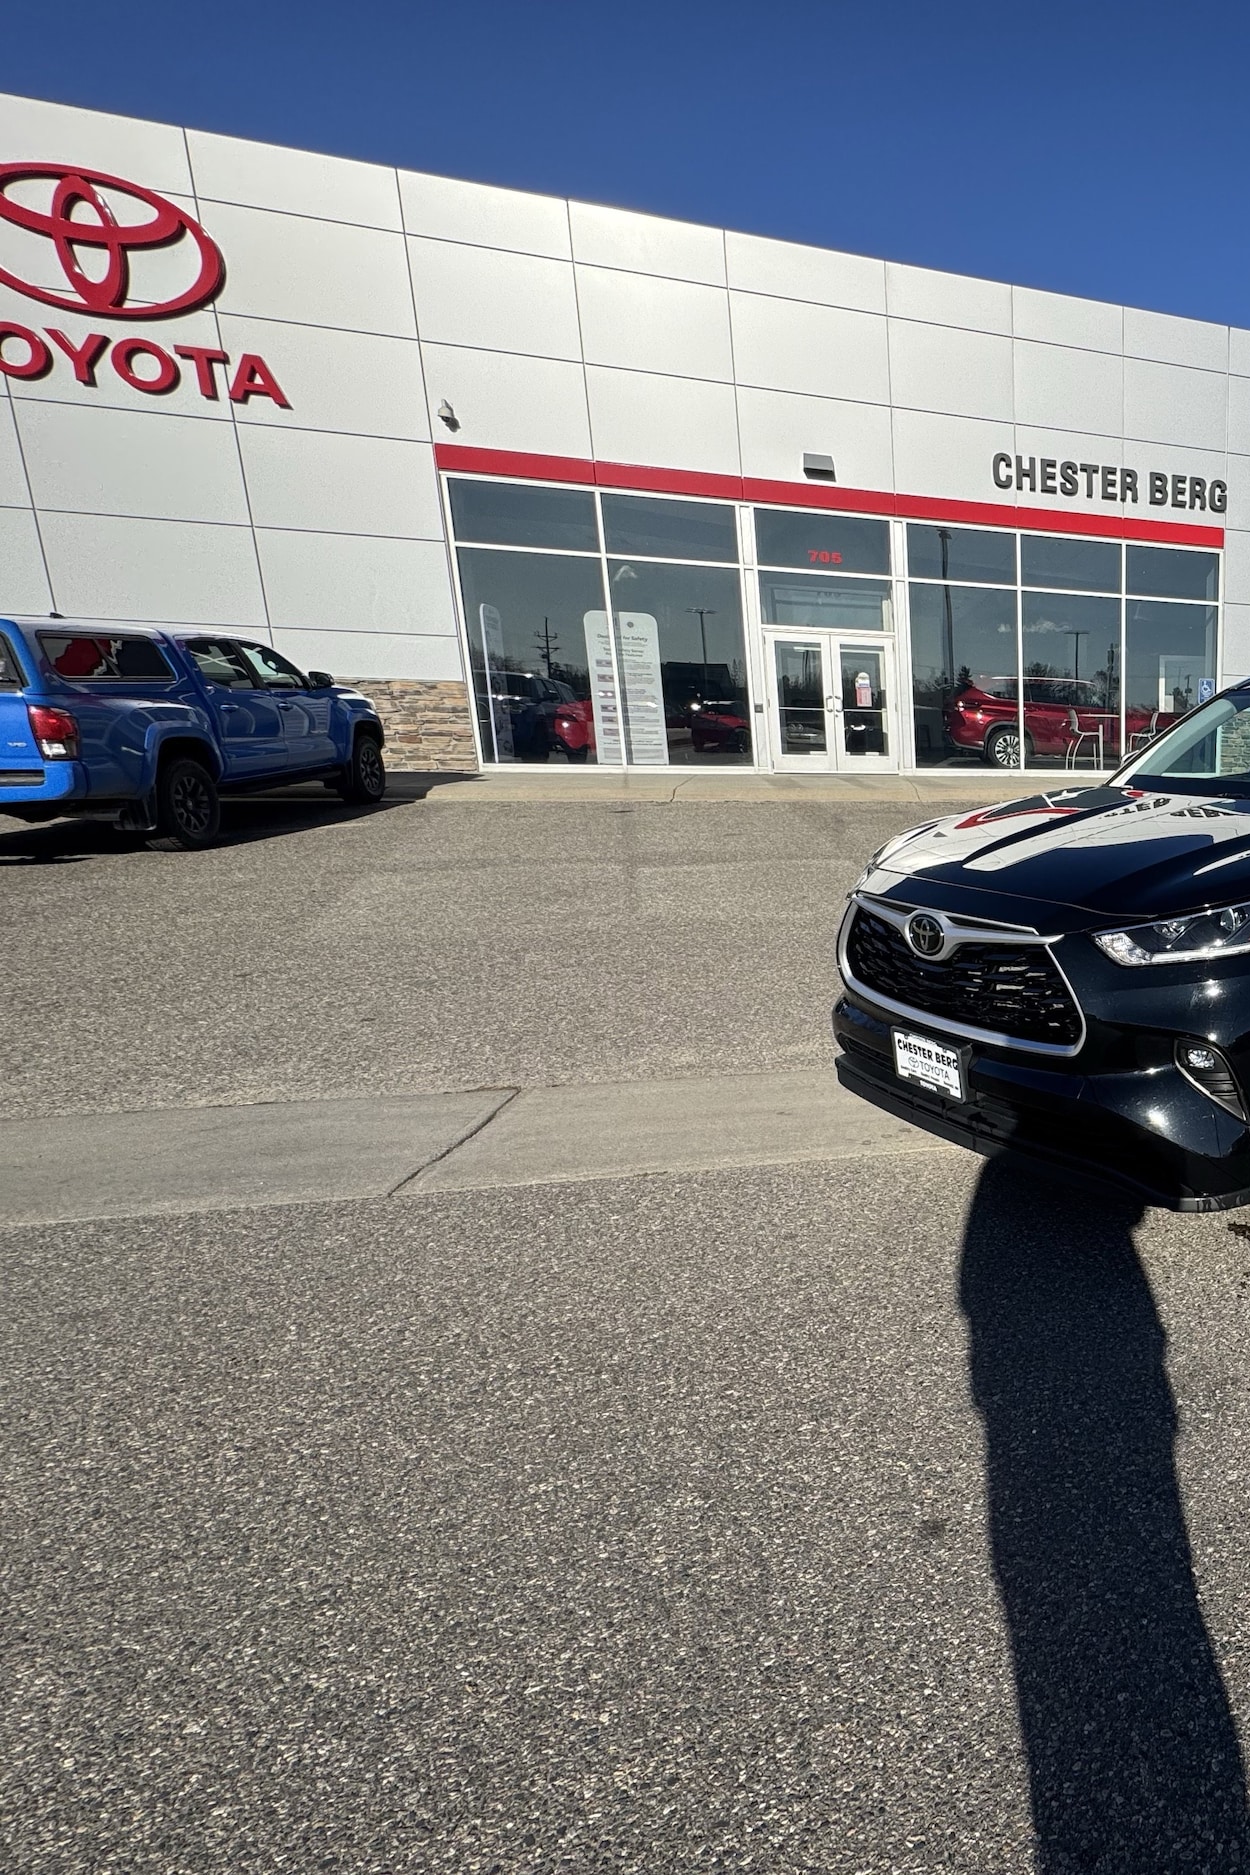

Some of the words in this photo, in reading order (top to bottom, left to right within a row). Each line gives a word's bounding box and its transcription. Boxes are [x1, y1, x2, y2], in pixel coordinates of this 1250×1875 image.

[0, 321, 293, 409] OYOTA
[992, 452, 1138, 503] CHESTER
[1149, 471, 1228, 513] BERG
[807, 549, 843, 565] 705
[897, 1038, 934, 1062] CHESTER
[934, 1051, 959, 1070] BERG
[920, 1060, 950, 1081] TOYOTA
